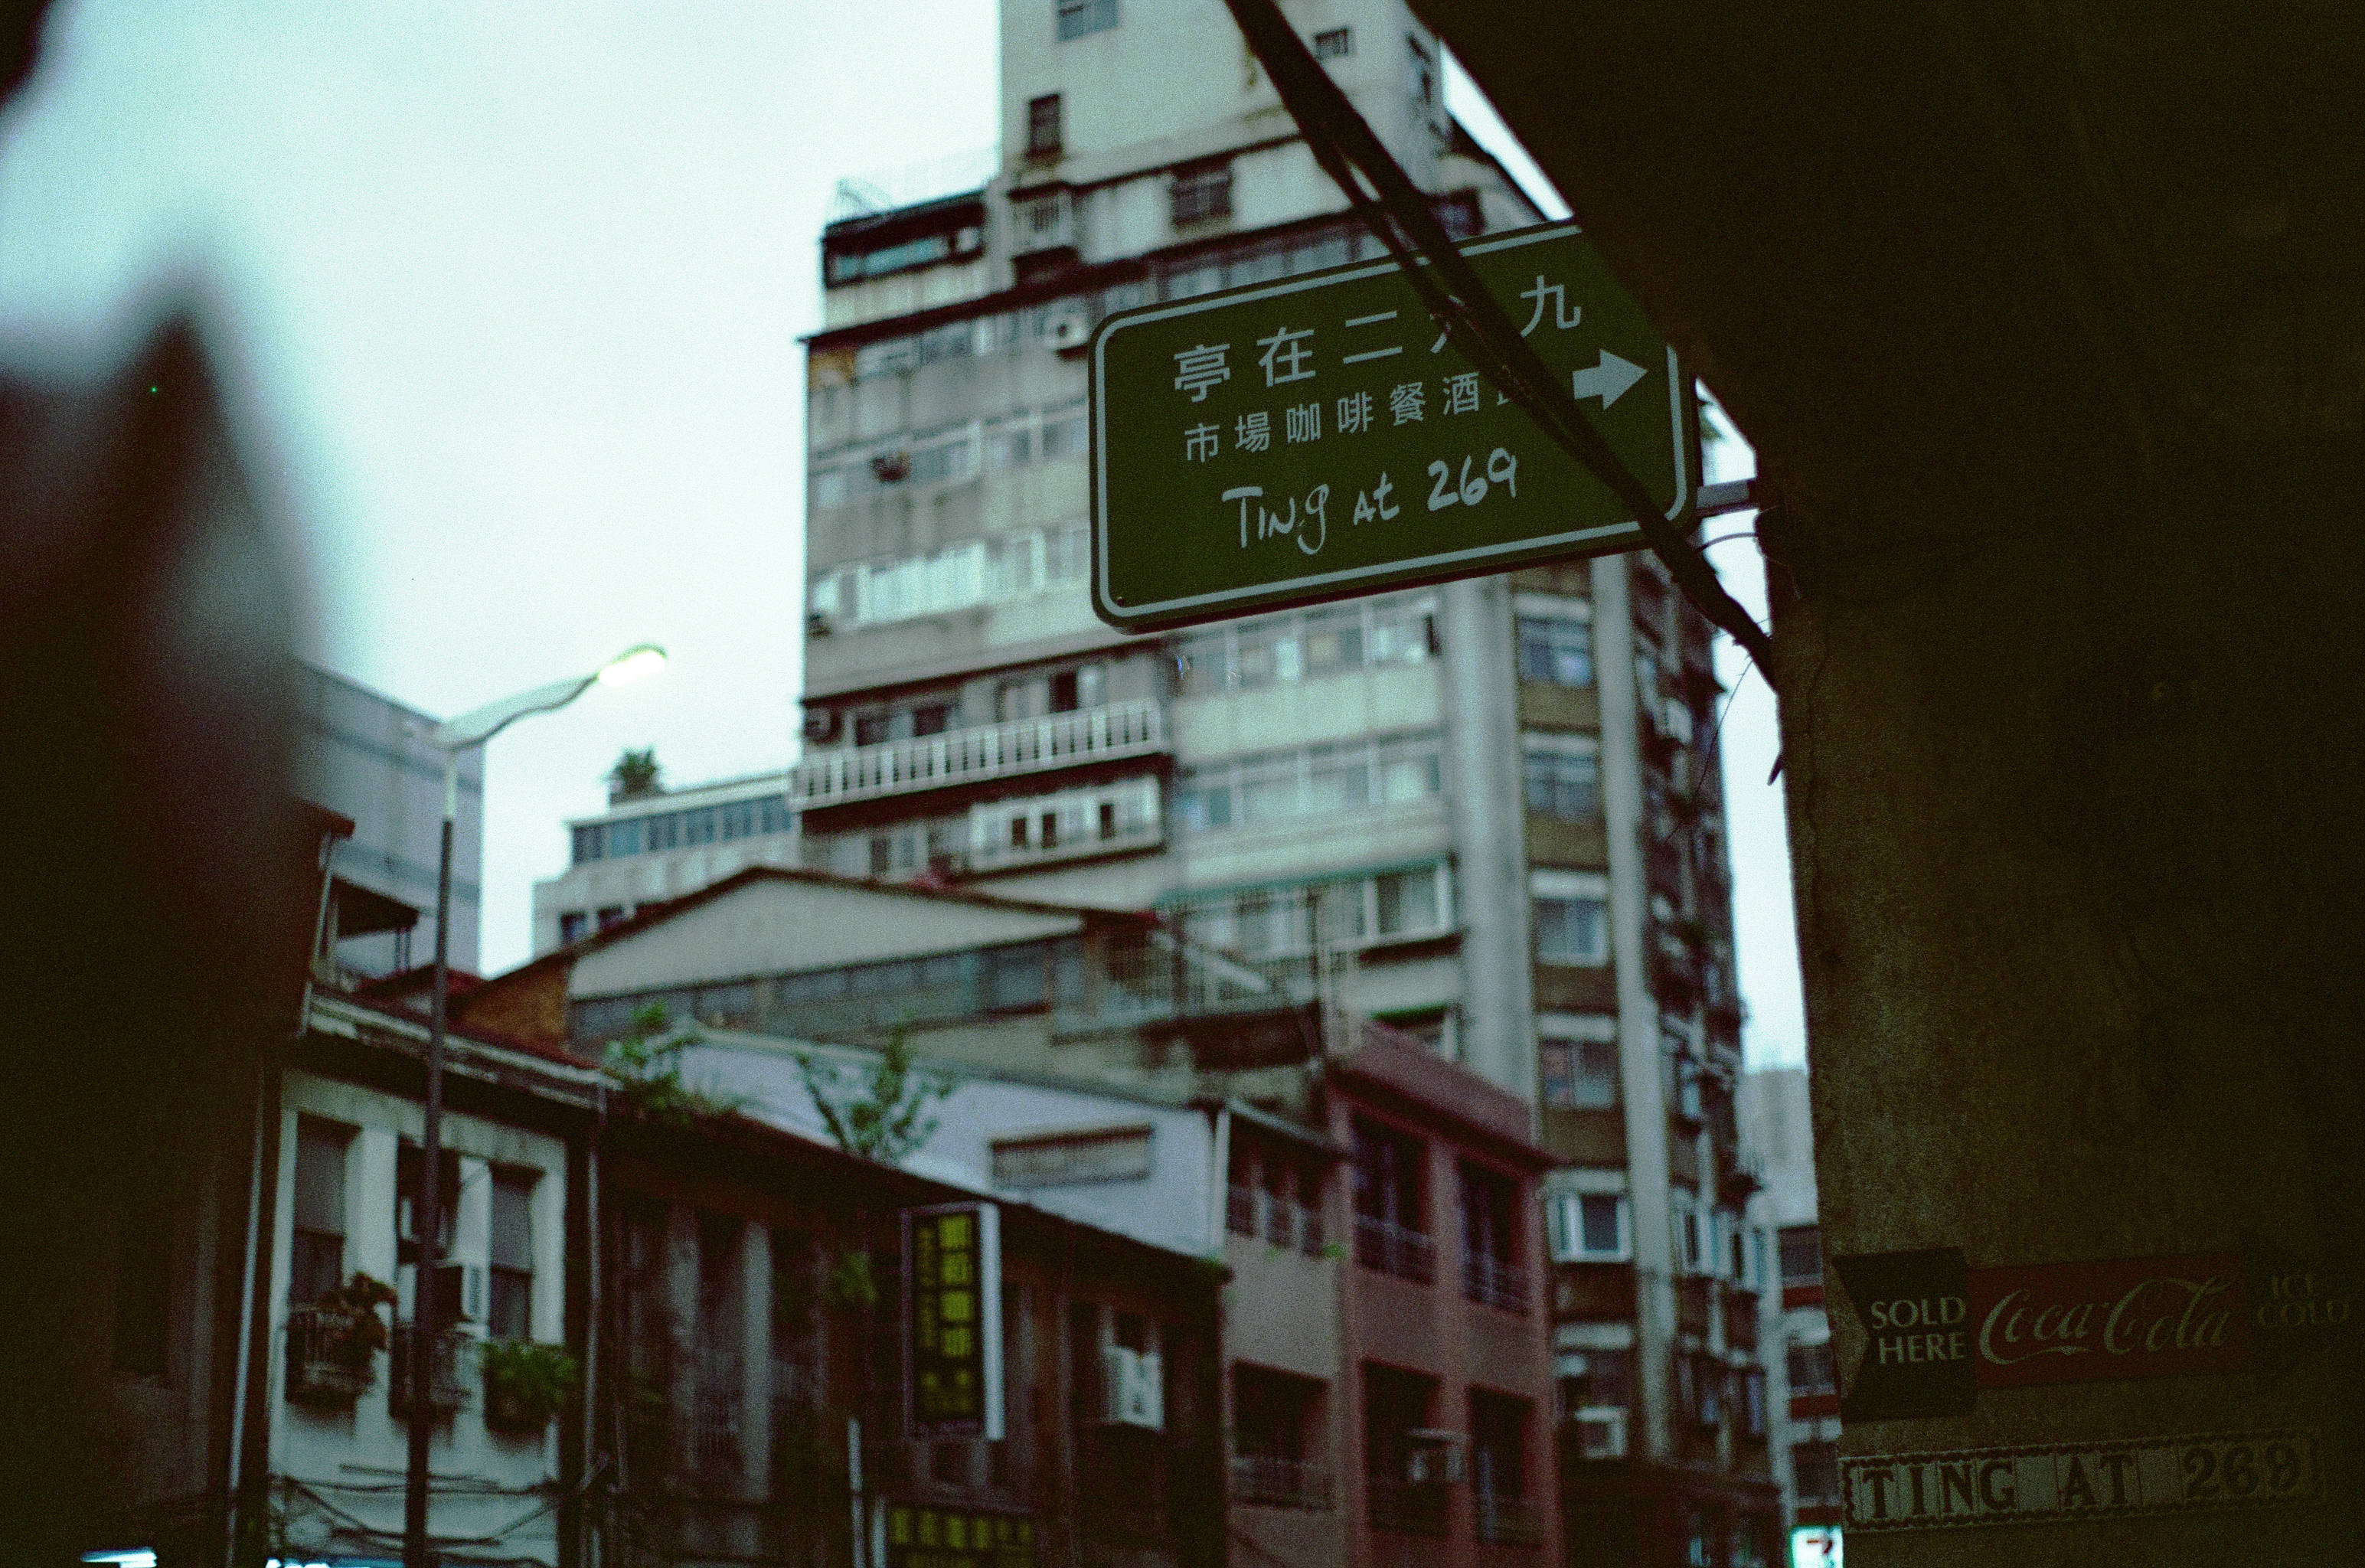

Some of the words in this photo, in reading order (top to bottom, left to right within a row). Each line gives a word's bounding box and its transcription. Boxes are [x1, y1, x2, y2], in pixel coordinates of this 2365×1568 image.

[1184, 369, 1524, 464] 市場咖啡餐酒
[1426, 446, 1518, 513] 269
[2271, 1273, 2315, 1300] ICE
[1870, 1295, 1967, 1331] SOLD
[2257, 1298, 2350, 1329] COLD
[1878, 1331, 1966, 1365] HERE
[1863, 1460, 2015, 1519] TING
[2063, 1453, 2136, 1509] AT
[2184, 1442, 2298, 1498] 269
